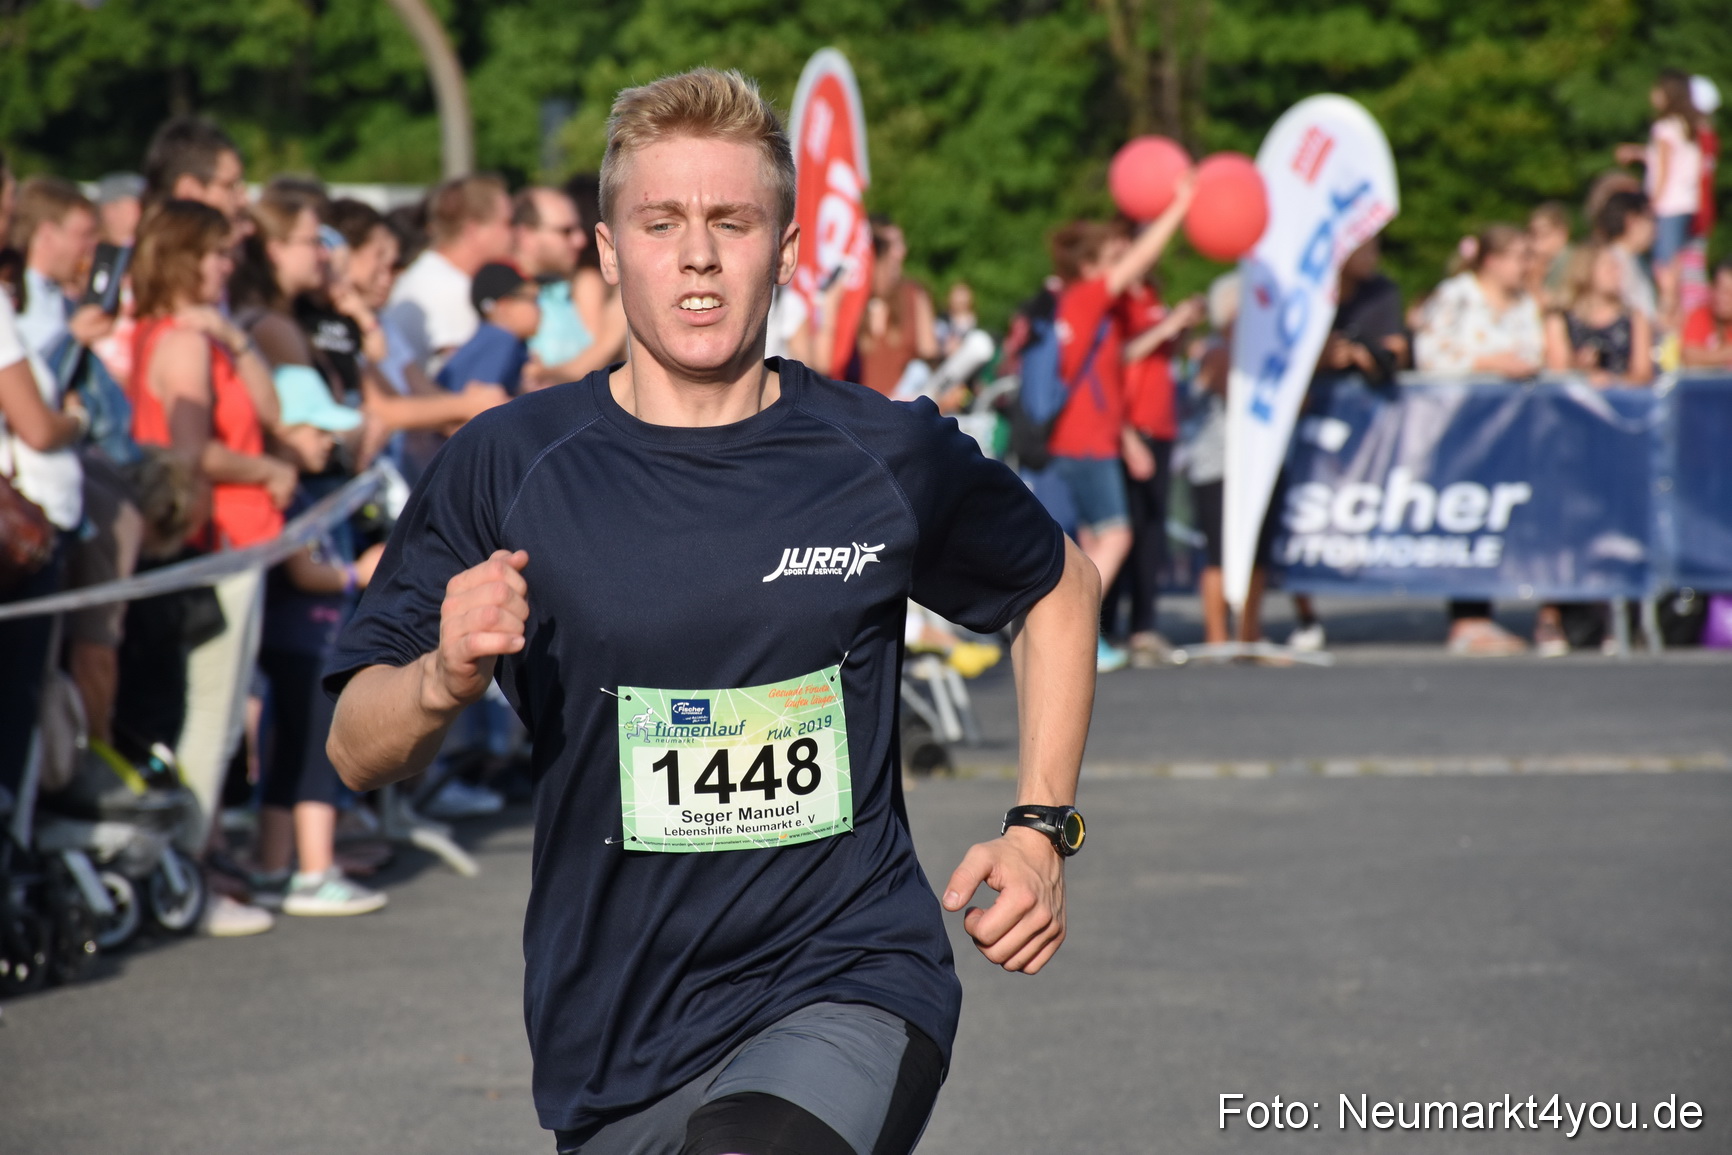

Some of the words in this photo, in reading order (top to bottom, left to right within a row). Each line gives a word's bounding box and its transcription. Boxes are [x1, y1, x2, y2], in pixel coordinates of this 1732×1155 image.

[1283, 466, 1532, 534] scher
[762, 547, 852, 583] JURA
[783, 568, 807, 576] SPORT
[814, 567, 843, 575] SERVICE
[678, 704, 705, 713] Fischer
[655, 719, 747, 737] firmenlauf
[798, 714, 832, 735] 2019
[652, 737, 822, 806] 1448
[681, 809, 733, 826] Seger
[738, 801, 800, 821] Manuel
[664, 825, 733, 837] Lebenshilfe
[736, 820, 793, 834] Neumarkt
[795, 819, 805, 827] e.
[808, 814, 815, 824] V
